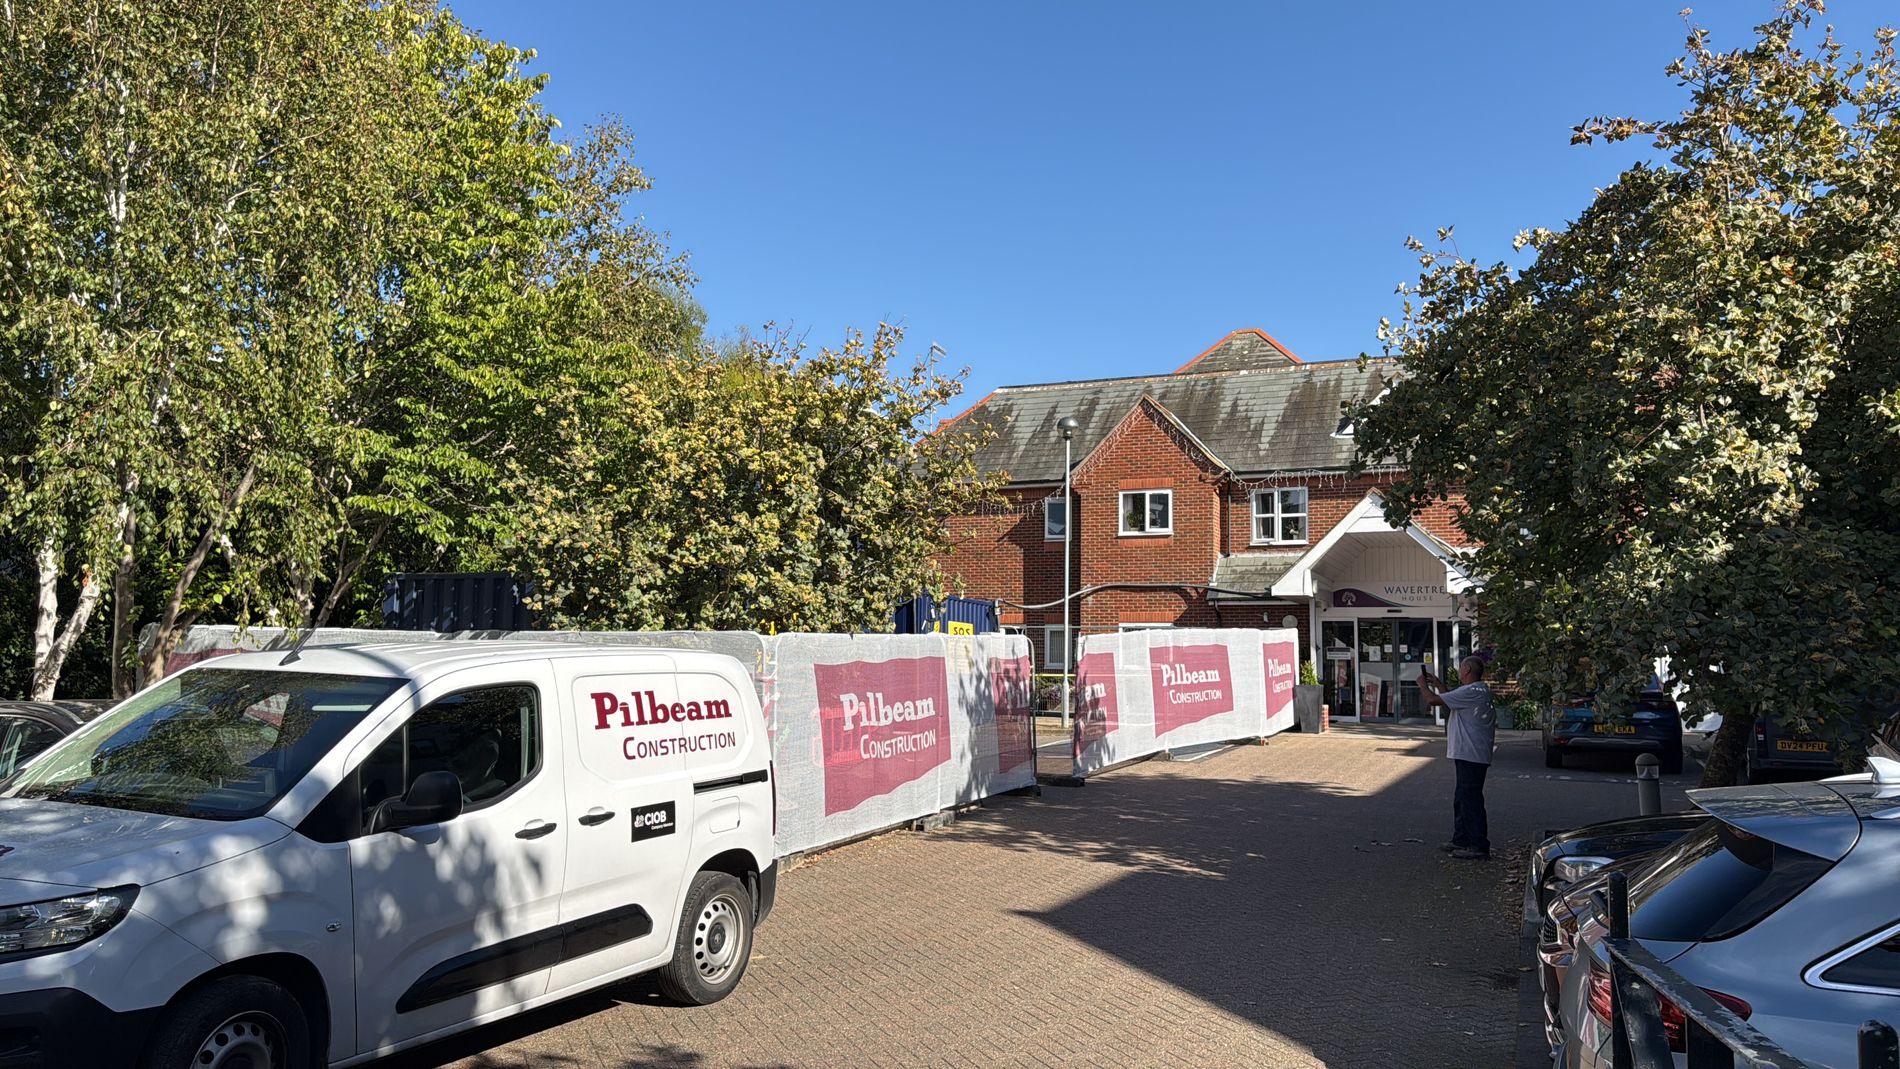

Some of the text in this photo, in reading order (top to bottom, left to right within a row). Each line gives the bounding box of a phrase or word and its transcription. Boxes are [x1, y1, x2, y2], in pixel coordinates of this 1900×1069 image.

[1160, 663, 1221, 687] Pilbeam
[1267, 658, 1292, 678] Pilbeam
[1169, 689, 1223, 704] CONSTRUCTION
[590, 690, 732, 730] Pilbeam
[839, 691, 936, 731] Pilbeam
[623, 731, 736, 760] CONSTRUCTION
[860, 728, 936, 759] CONSTRUCTION
[645, 811, 667, 825] CIOB
